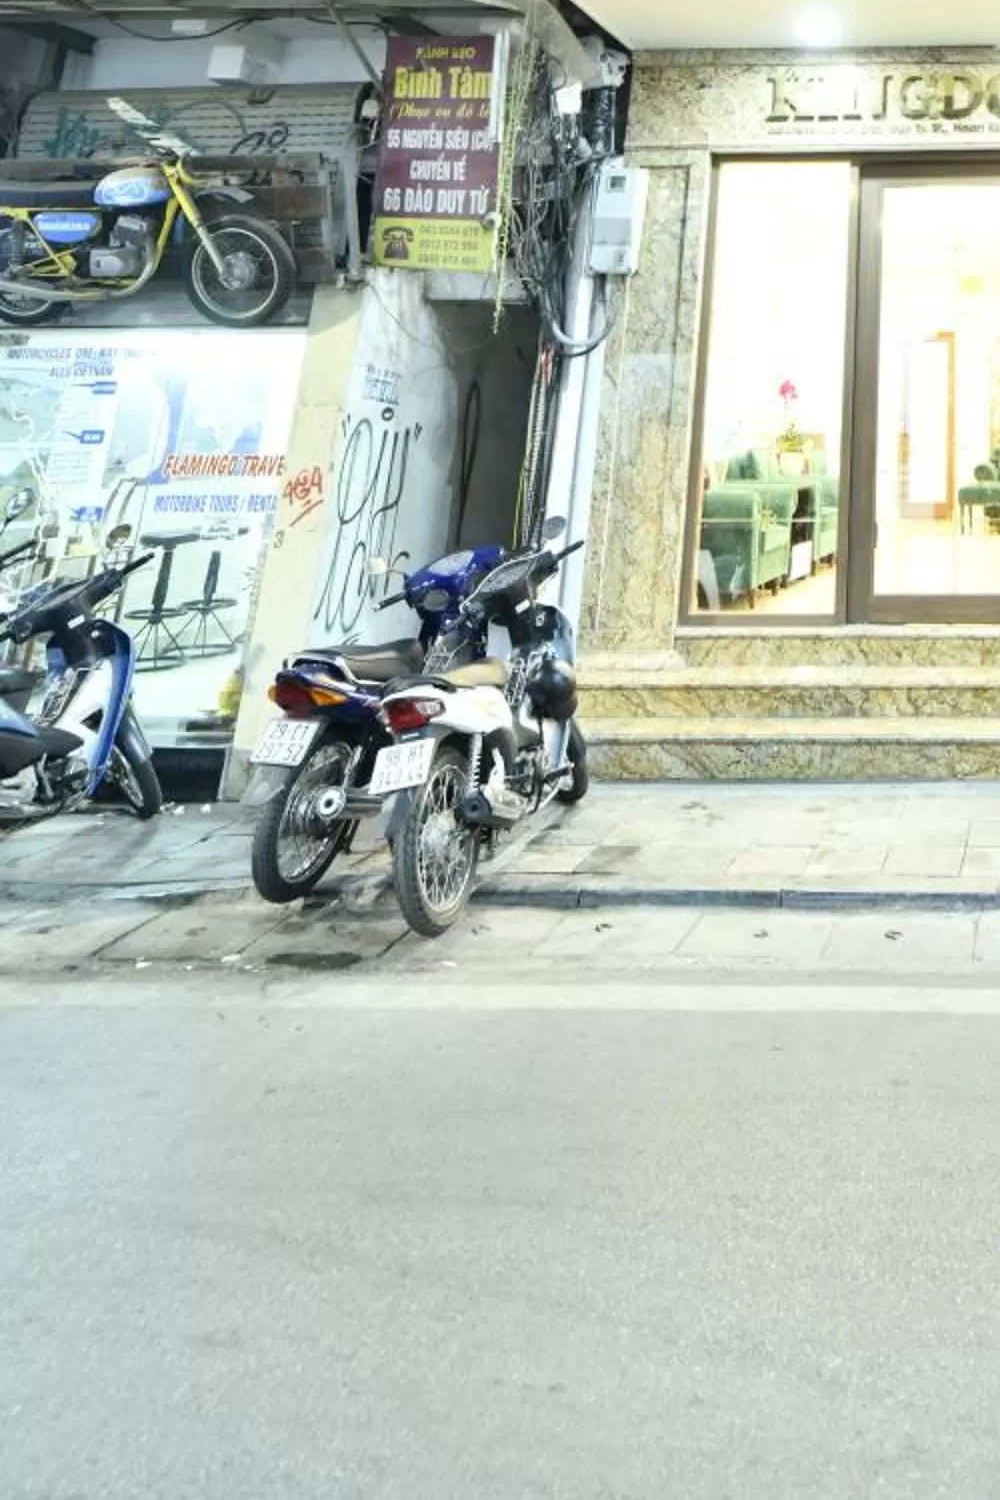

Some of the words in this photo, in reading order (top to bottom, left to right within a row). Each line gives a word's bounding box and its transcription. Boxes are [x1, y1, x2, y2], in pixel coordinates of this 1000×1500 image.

[383, 187, 401, 213] 66
[436, 188, 467, 214] DUY
[164, 454, 239, 477] FLAMINGO
[242, 455, 287, 477] TRAVE
[247, 494, 277, 513] RENTA
